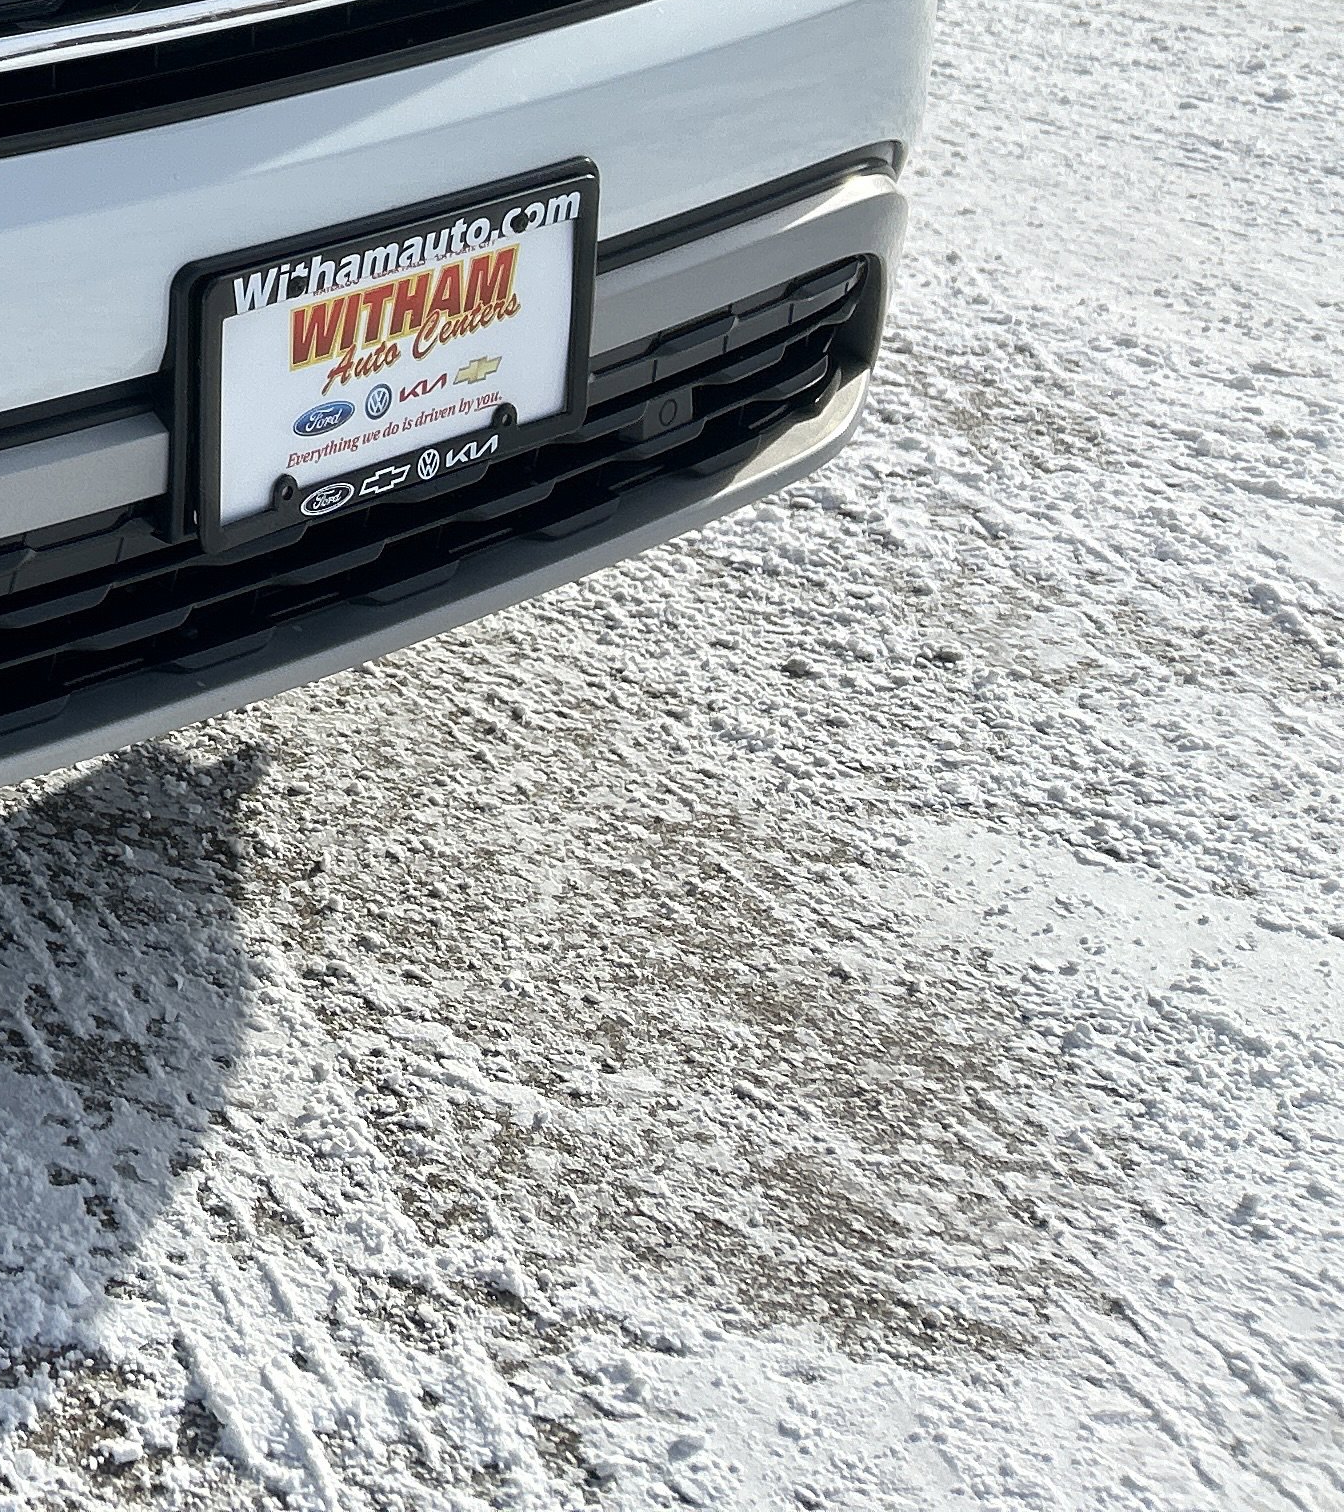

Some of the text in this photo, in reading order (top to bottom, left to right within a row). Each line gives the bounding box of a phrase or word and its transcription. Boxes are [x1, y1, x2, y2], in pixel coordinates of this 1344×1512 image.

[290, 245, 520, 371] WITHAM
[322, 292, 522, 396] Auto Centers
[286, 391, 503, 469] Everything we do is driven by you.
